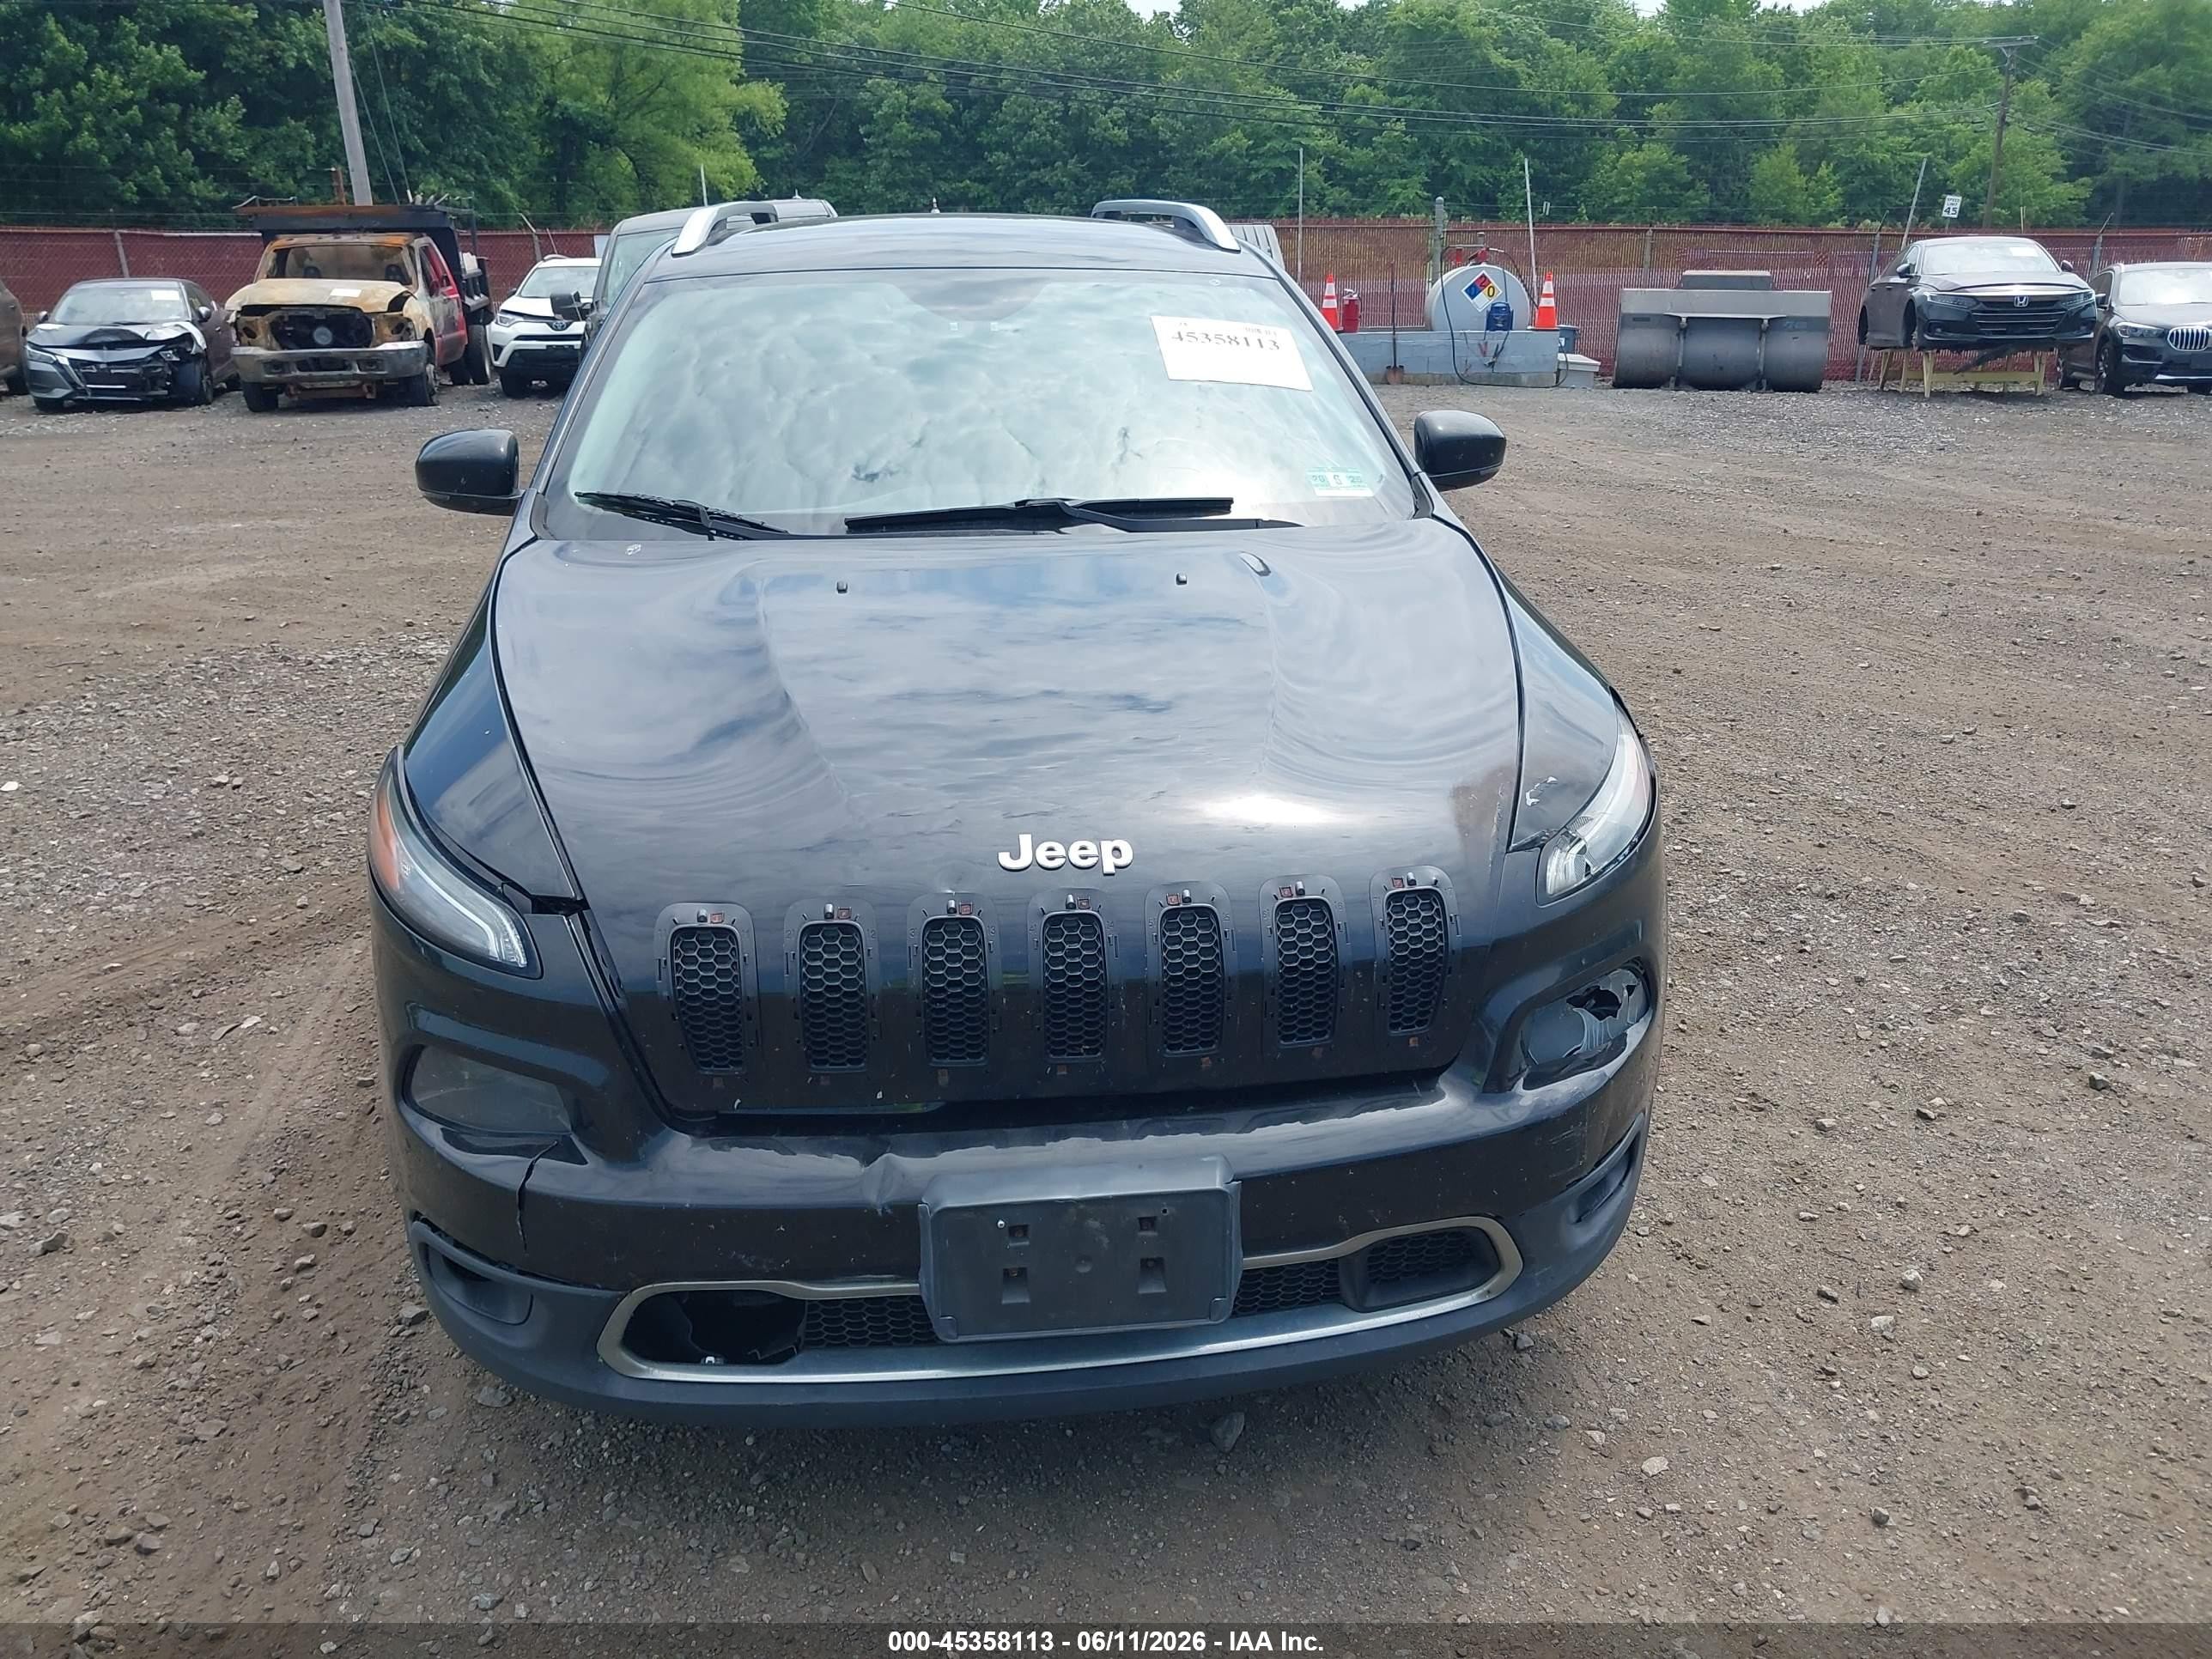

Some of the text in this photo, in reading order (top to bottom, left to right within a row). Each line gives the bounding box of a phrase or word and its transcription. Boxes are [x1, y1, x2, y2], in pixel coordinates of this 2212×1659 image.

[1943, 207, 1958, 216] 45
[1487, 285, 1495, 297] 0
[1170, 331, 1280, 350] 45358113
[998, 833, 1133, 876] Jeep
